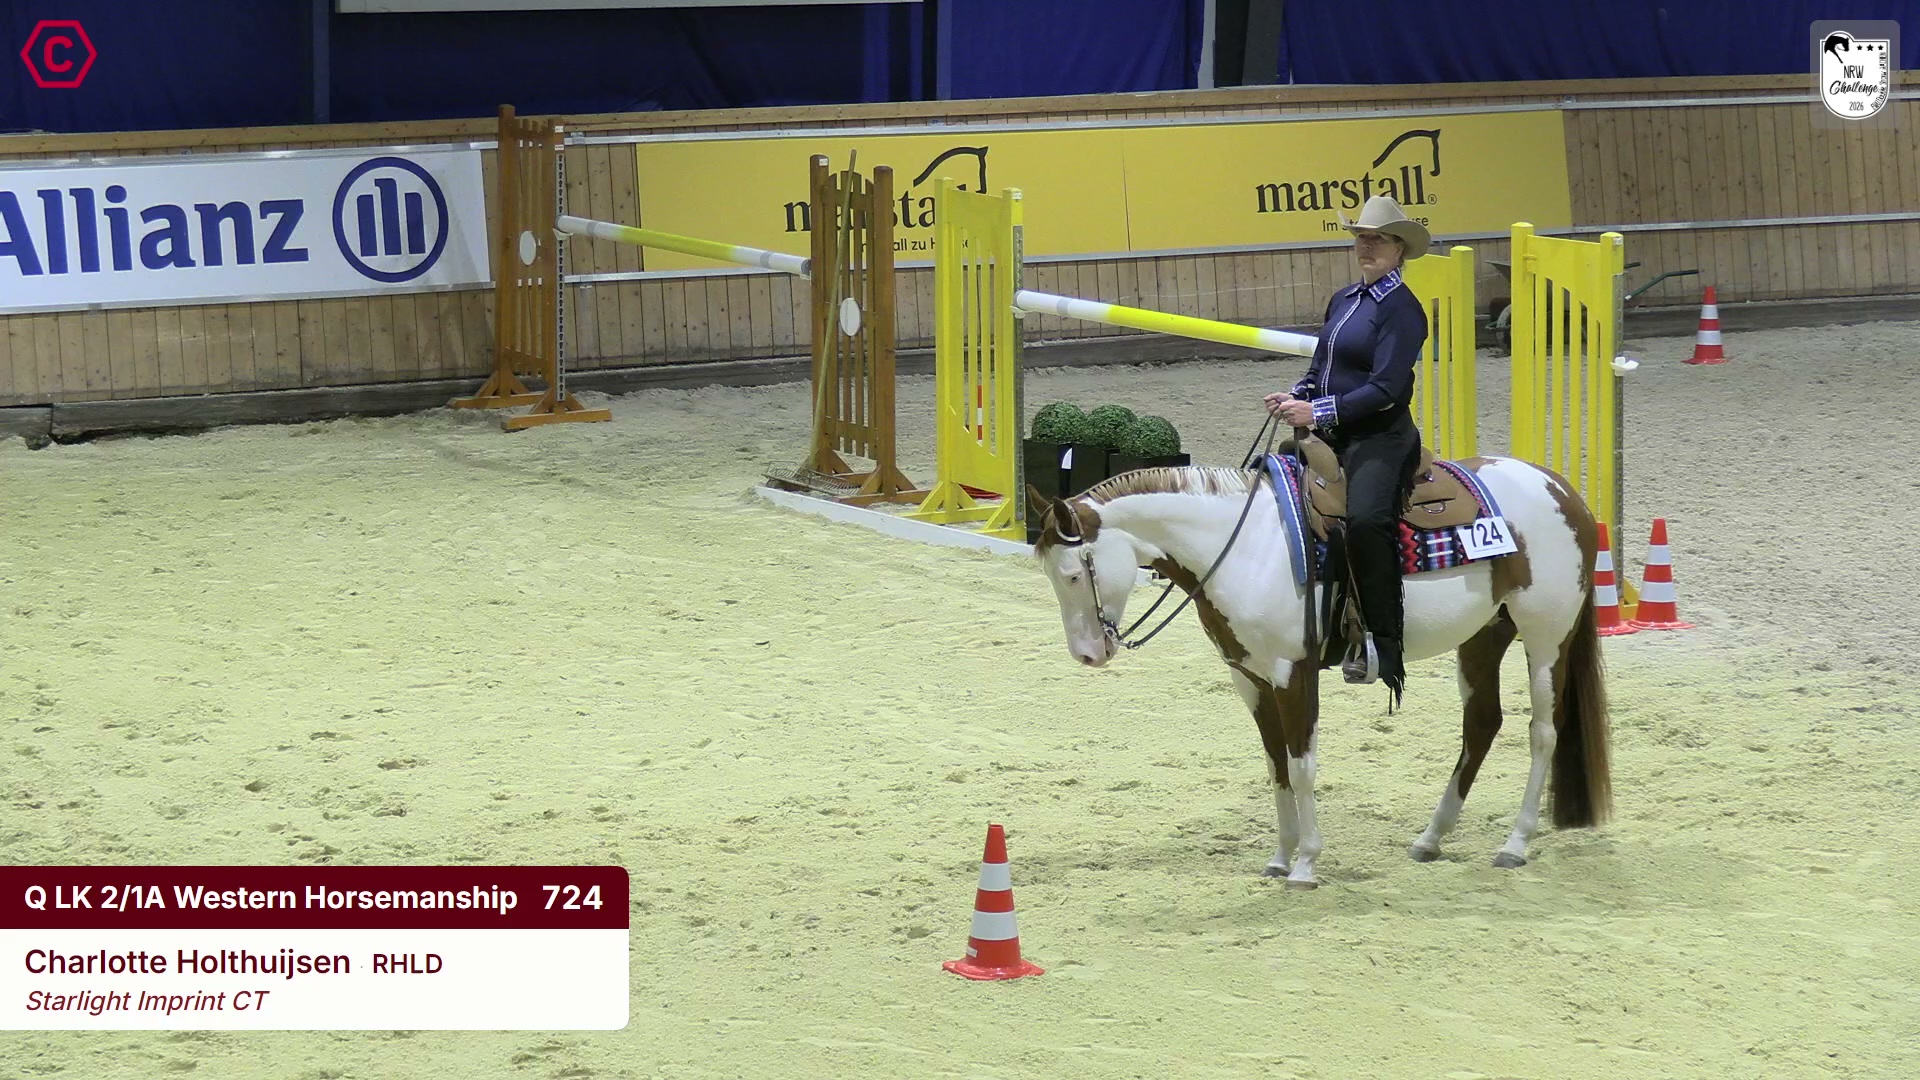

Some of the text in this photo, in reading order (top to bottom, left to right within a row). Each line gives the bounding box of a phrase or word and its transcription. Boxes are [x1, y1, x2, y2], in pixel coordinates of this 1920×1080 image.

[0, 184, 309, 276] Allianz
[1322, 219, 1338, 232] Im
[911, 240, 927, 251] zu
[1463, 521, 1503, 548] 724
